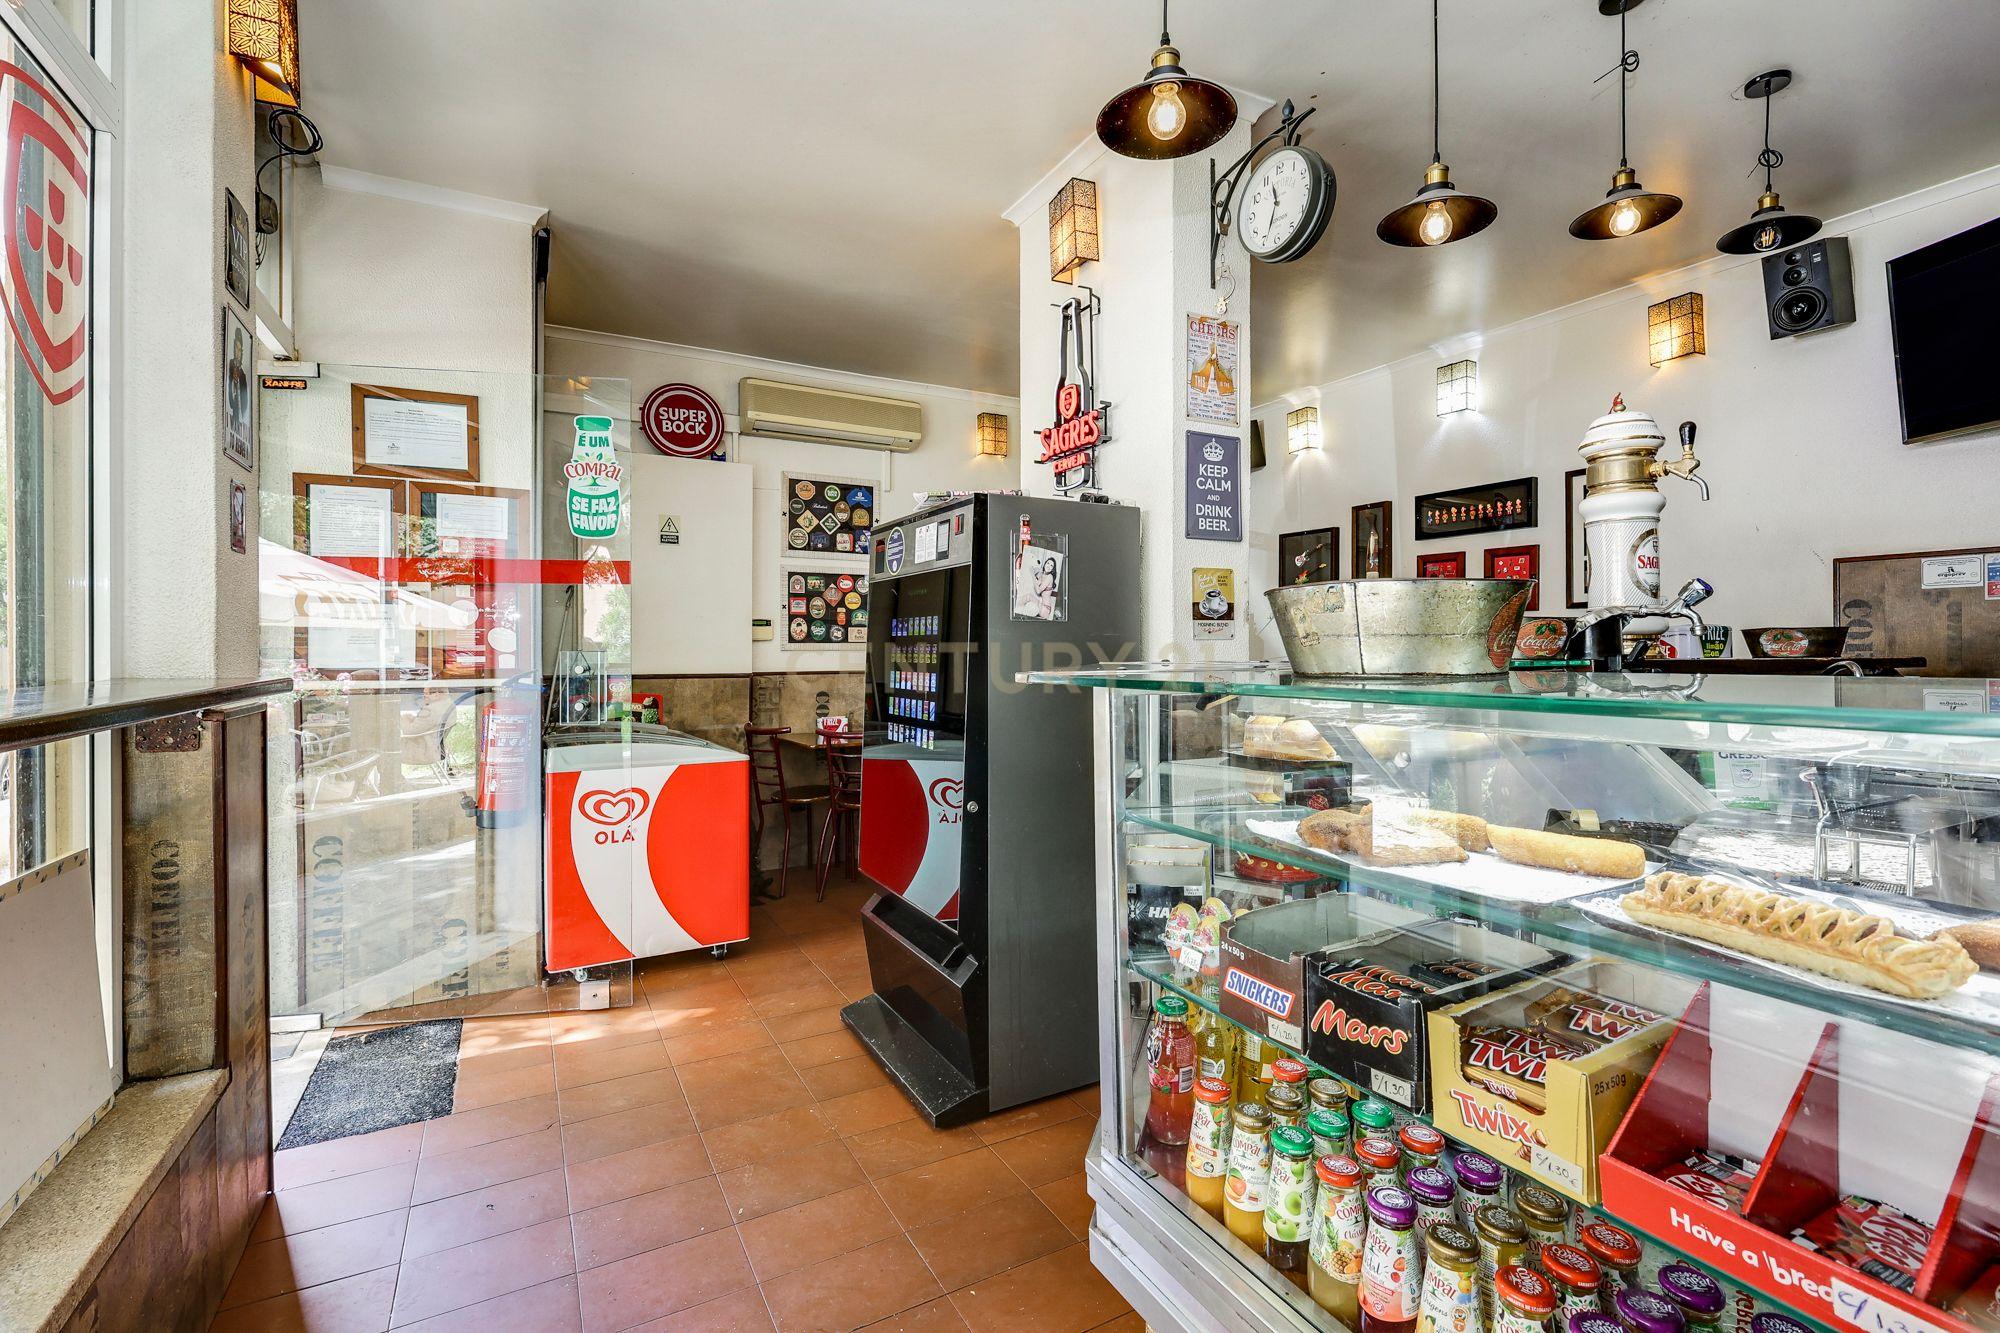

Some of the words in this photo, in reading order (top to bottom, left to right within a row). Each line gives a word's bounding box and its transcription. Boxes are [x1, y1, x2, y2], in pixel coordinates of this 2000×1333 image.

[1190, 320, 1236, 340] CHEERS
[659, 407, 707, 423] SUPER
[662, 420, 706, 435] BOCK
[1040, 410, 1100, 462] SAGRES
[589, 436, 610, 448] UM
[1052, 451, 1087, 473] CERVEJA
[1199, 463, 1229, 478] KEEP
[1196, 478, 1231, 492] CALM
[572, 495, 589, 513] SE
[591, 495, 618, 514] FAZ
[1195, 504, 1233, 518] DRINK
[571, 513, 618, 531] FAVOR
[1198, 518, 1231, 532] BEER.
[1637, 554, 1661, 569] SAG
[594, 824, 635, 845] OLÁ
[150, 839, 181, 960] COFFEE
[311, 834, 344, 972] COFFEE
[1227, 970, 1290, 1015] SNICKERS
[1327, 970, 1404, 999] Mar
[1310, 999, 1408, 1055] Mars
[1483, 1078, 1518, 1100] Twix
[1450, 1088, 1535, 1146] Twix
[1669, 1207, 1736, 1257] Have
[1741, 1249, 1760, 1268] a
